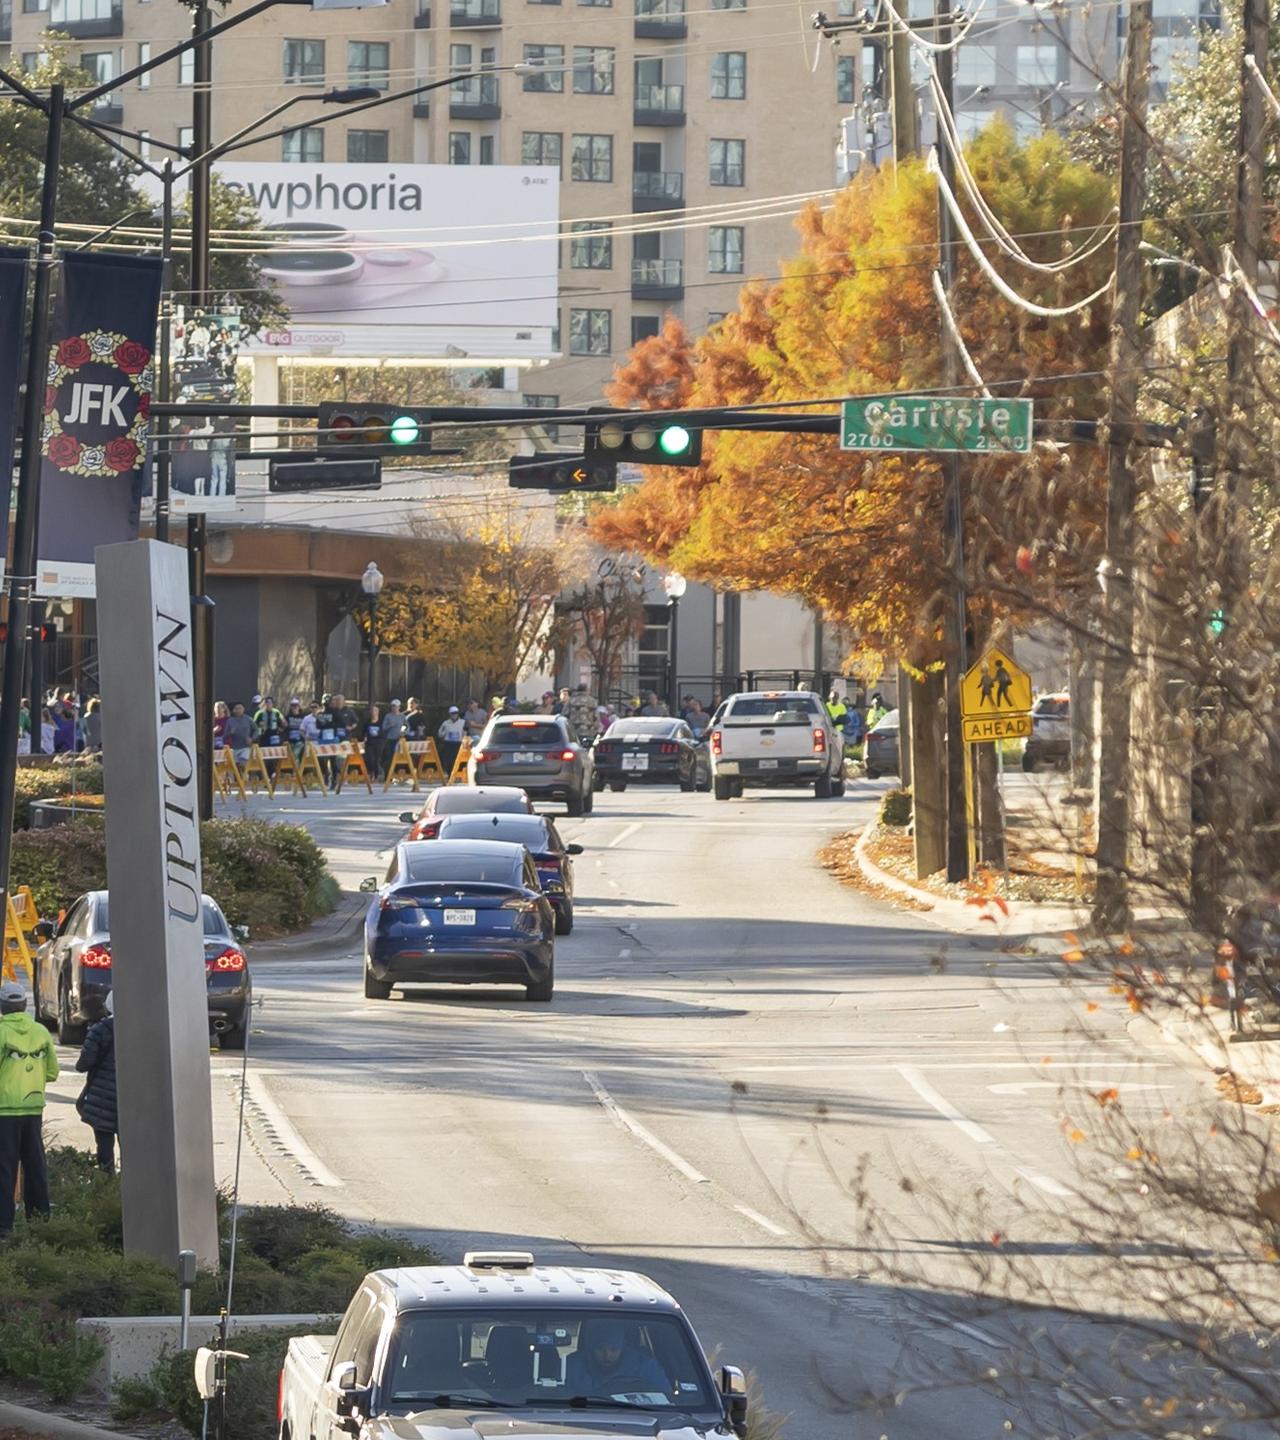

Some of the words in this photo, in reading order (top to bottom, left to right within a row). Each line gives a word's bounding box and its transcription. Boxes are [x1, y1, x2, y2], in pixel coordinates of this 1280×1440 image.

[64, 382, 130, 427] JFK
[848, 433, 894, 447] 2700
[971, 720, 1027, 737] AHEAD
[156, 604, 202, 923] UPTOWN
